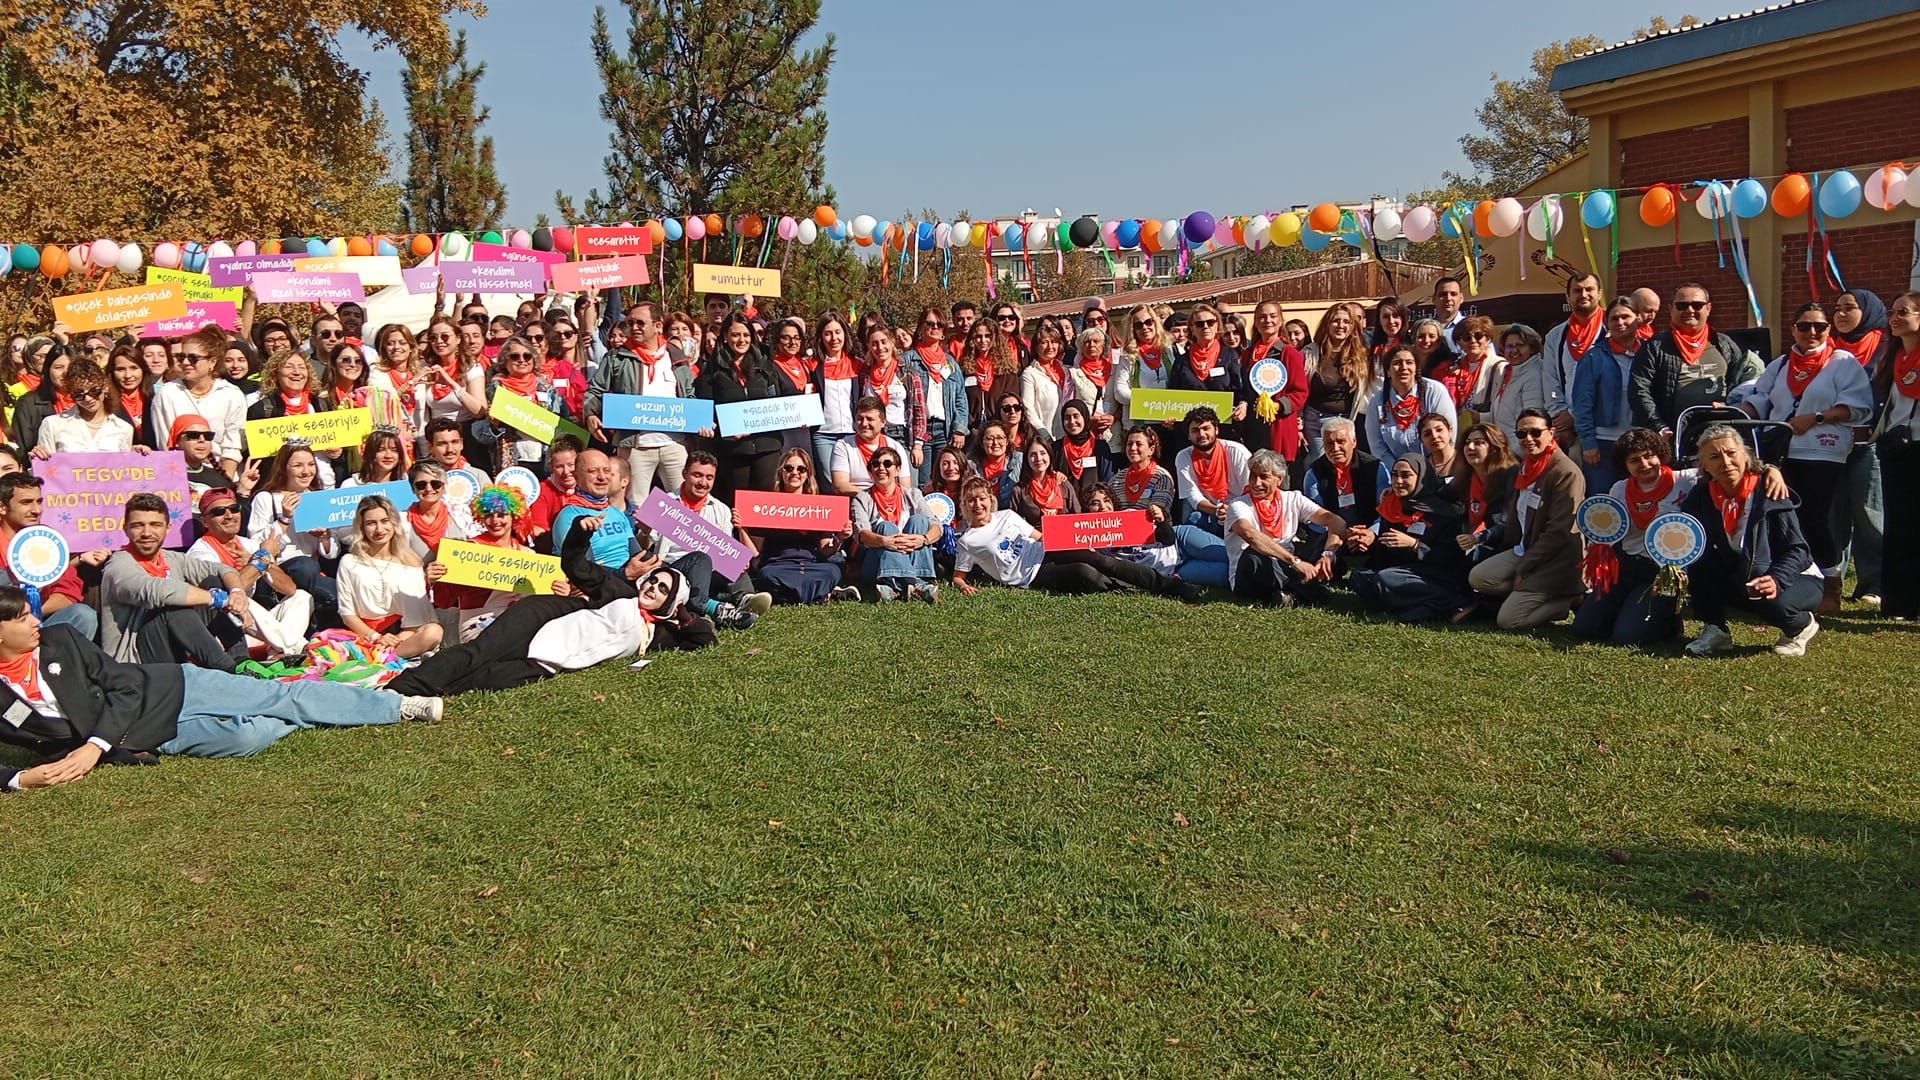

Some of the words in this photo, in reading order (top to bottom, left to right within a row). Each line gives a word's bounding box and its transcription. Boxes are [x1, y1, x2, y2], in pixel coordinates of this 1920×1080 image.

[669, 402, 685, 417] yol
[72, 466, 156, 482] TEGV'DE
[752, 504, 832, 519] #cesarettir
[1074, 530, 1124, 546] kaynağım
[499, 556, 556, 578] sesleriyle
